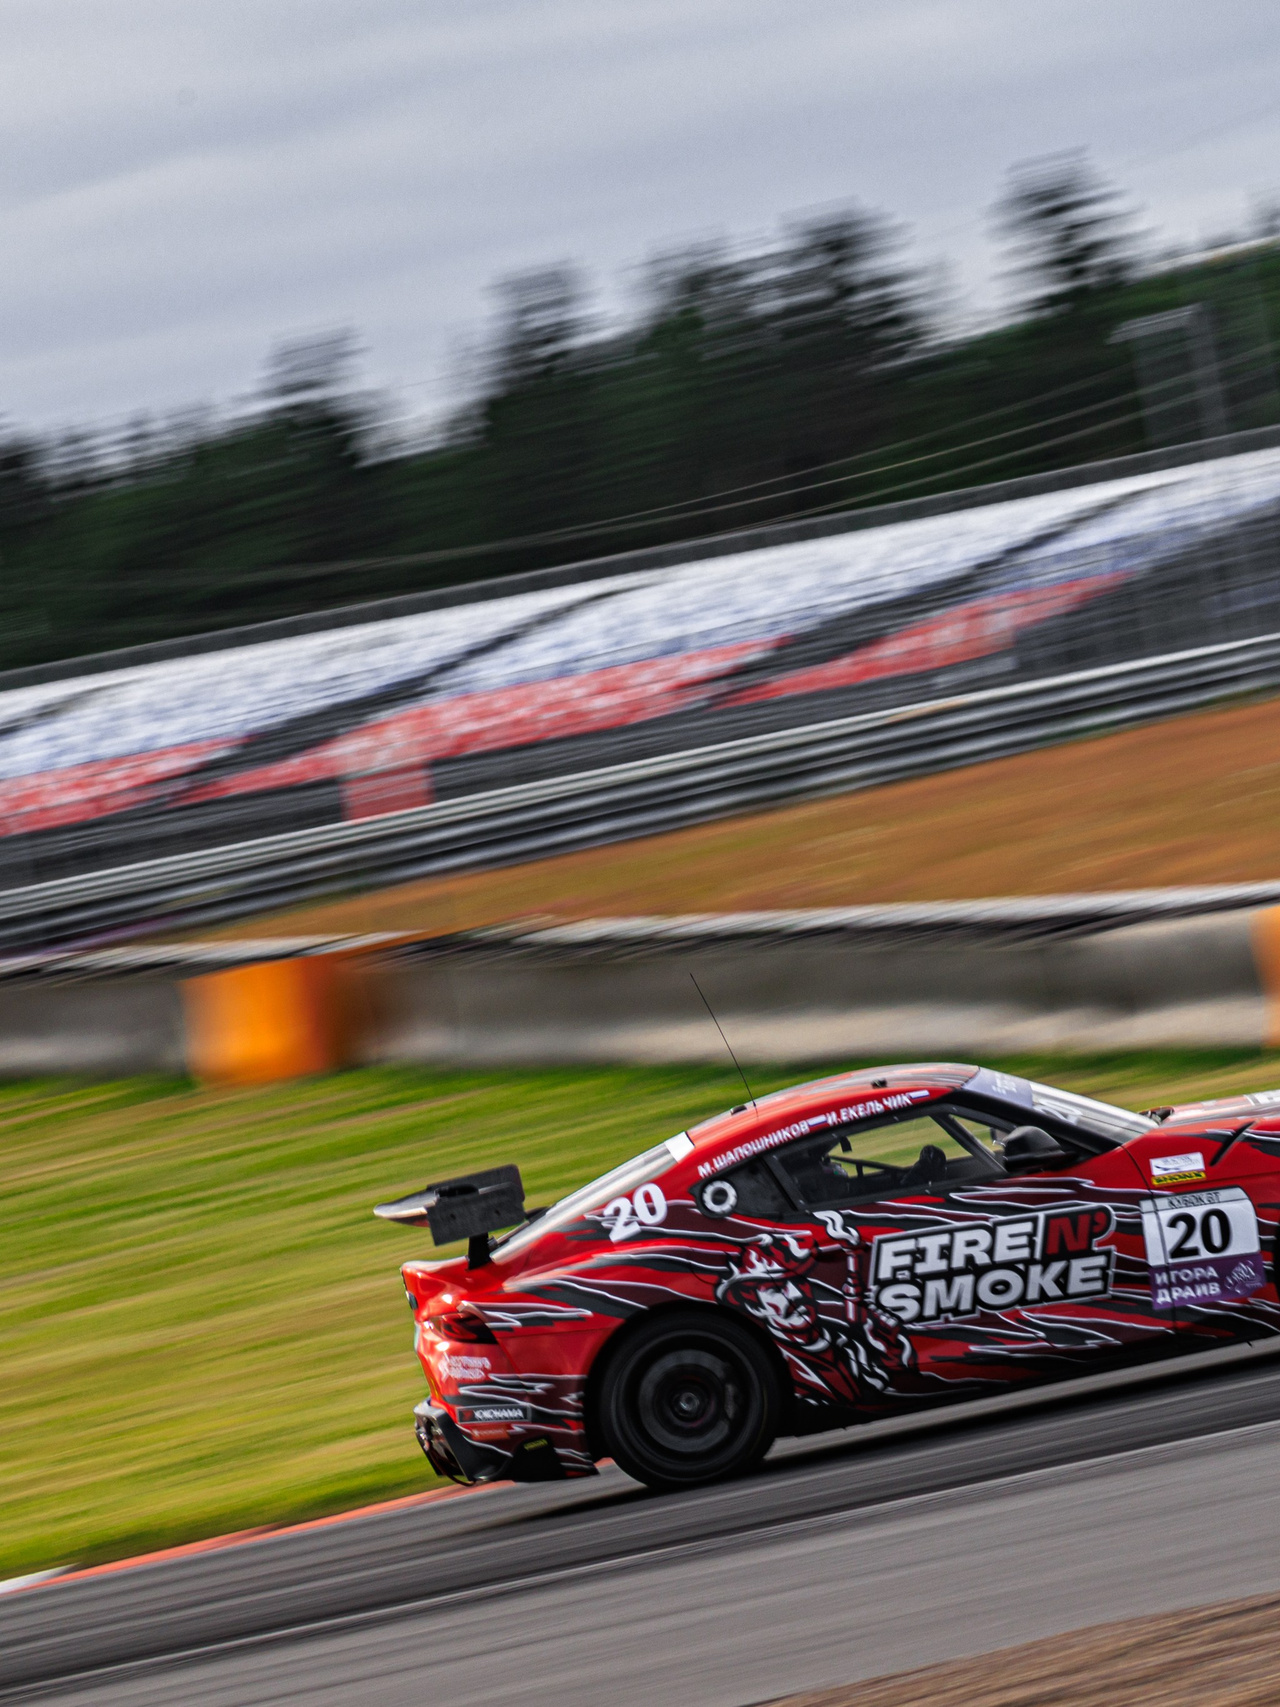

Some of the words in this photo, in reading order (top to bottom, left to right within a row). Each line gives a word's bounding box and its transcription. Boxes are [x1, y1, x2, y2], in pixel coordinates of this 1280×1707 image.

[603, 1183, 668, 1244] 20
[1166, 1208, 1232, 1260] 20
[878, 1221, 1034, 1281] FIRE
[1154, 1265, 1220, 1286] ИГОРА
[878, 1254, 1108, 1322] SMOKE
